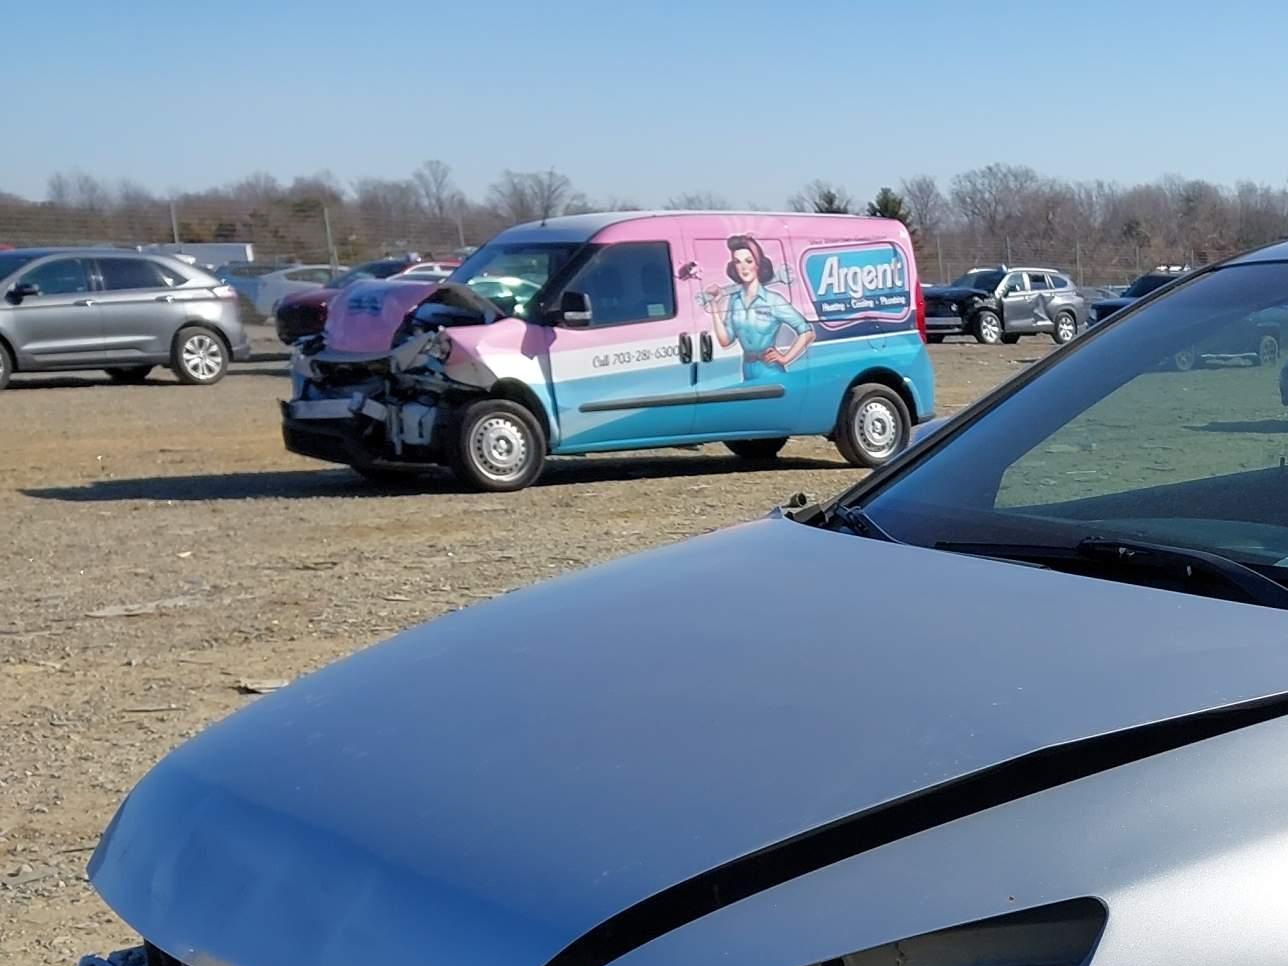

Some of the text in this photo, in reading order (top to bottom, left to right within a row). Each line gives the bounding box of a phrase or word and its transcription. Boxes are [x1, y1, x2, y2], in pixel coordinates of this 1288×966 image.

[817, 255, 903, 299] Argent
[821, 295, 906, 312] Heating Cooling Plumbing
[592, 354, 610, 369] Call
